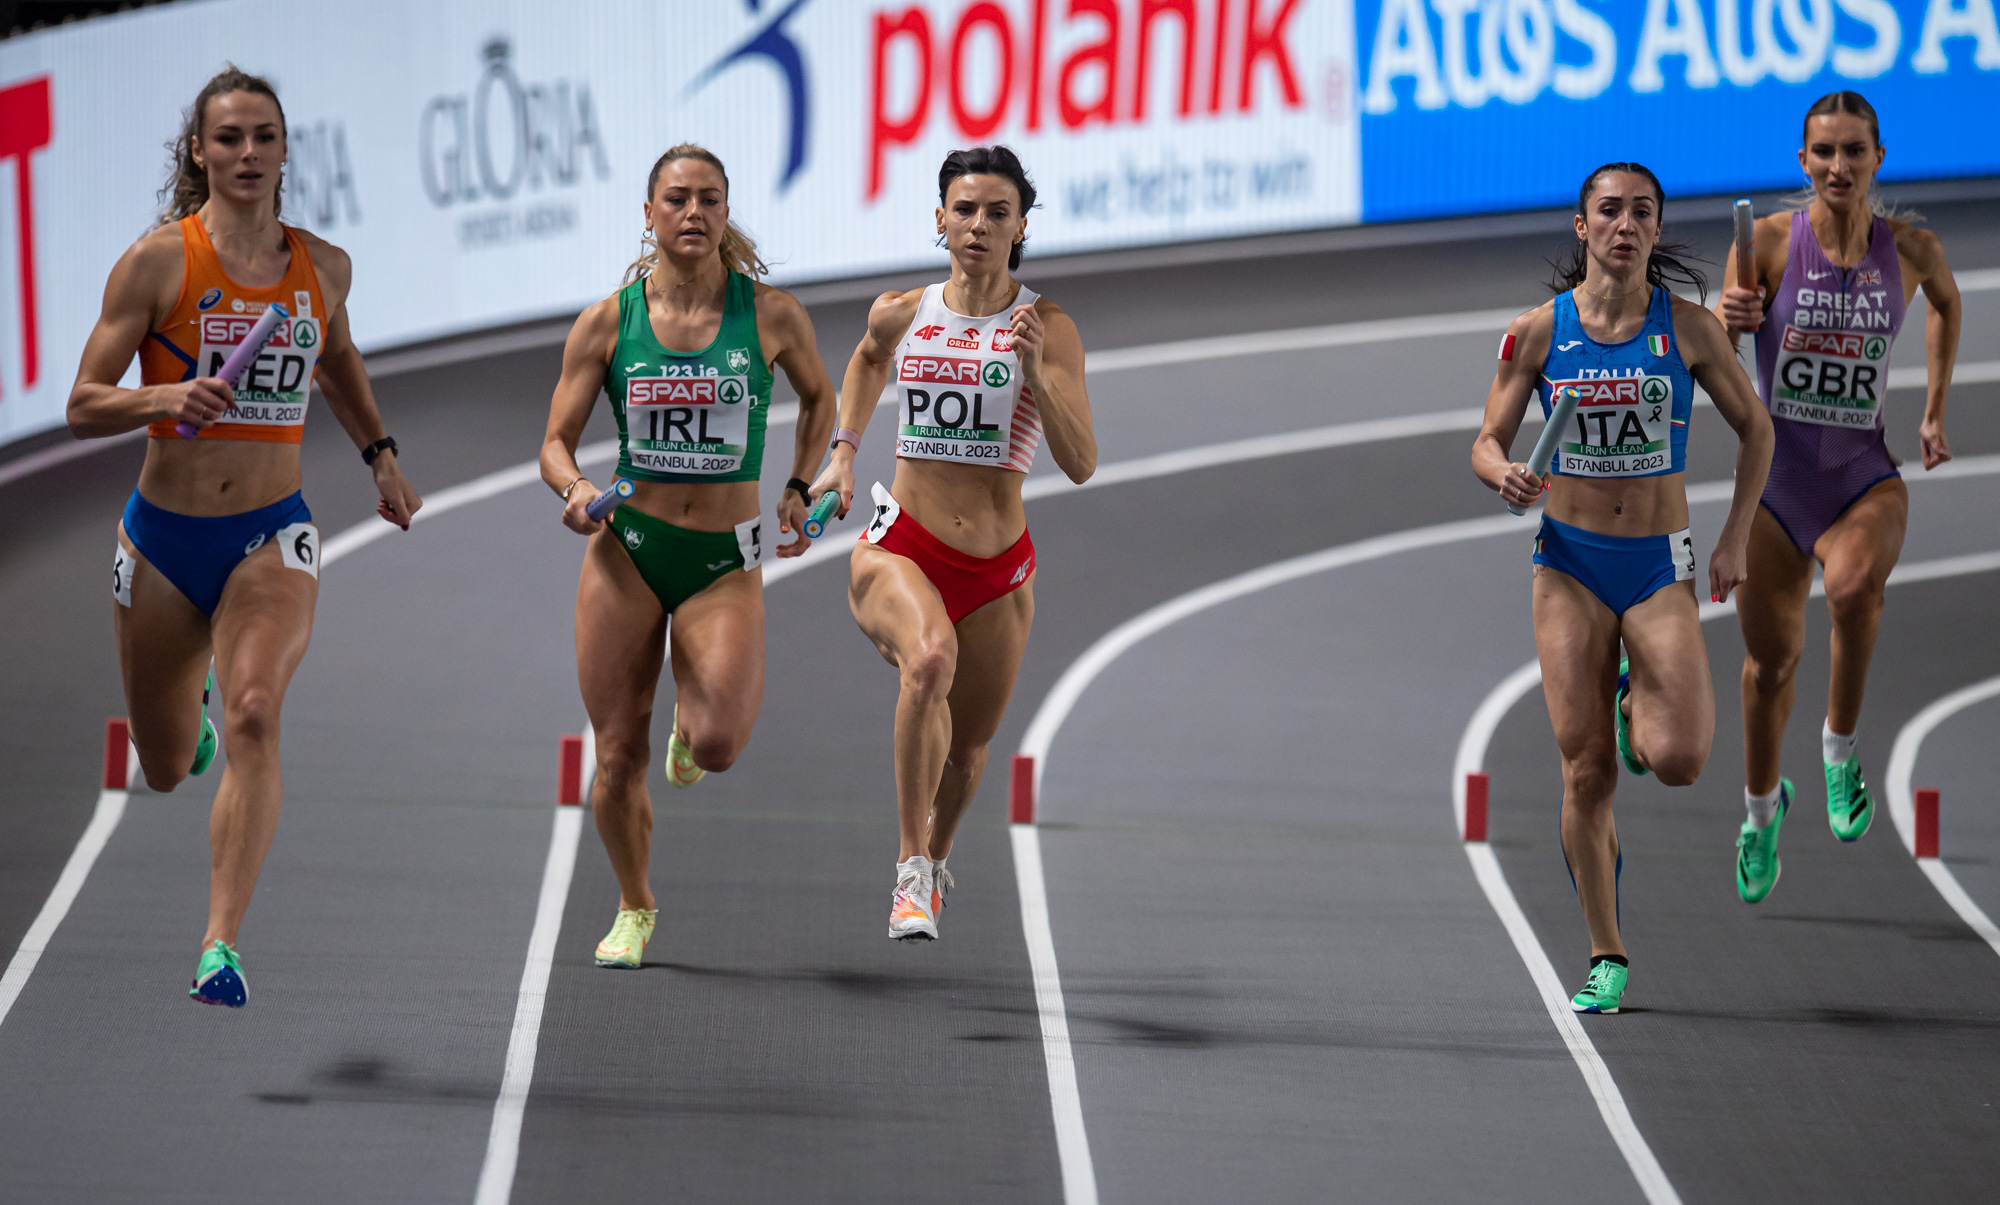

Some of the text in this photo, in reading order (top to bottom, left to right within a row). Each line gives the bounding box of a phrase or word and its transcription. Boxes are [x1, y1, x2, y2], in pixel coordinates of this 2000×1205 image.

[866, 0, 1305, 204] polanik
[418, 62, 611, 207] GLORIA
[1797, 287, 1887, 309] GREAT
[1794, 309, 1890, 328] BRITAIN
[206, 321, 289, 344] SPR
[914, 325, 946, 340] 4F
[948, 339, 978, 349] ORLEN
[1785, 333, 1861, 356] SPAR
[660, 364, 719, 378] 123ie
[902, 359, 979, 382] SPAR
[1577, 367, 1646, 379] ITALIA
[1781, 357, 1878, 401] GBR
[631, 382, 713, 402] SPAR
[1800, 393, 1822, 404] RUN
[222, 406, 273, 421] ANBUL
[906, 388, 999, 431] POL
[1777, 401, 1840, 423] ISTANBUL
[650, 407, 725, 445] IRL
[920, 427, 942, 437] RUN
[1576, 410, 1651, 448] ITA
[656, 441, 678, 451] RUN
[901, 439, 1000, 458] STANBUL 2023
[1585, 445, 1607, 456] RUN
[701, 458, 736, 470] 2023
[1566, 454, 1664, 473] ISTANBUL 2023
[294, 531, 313, 566] 6
